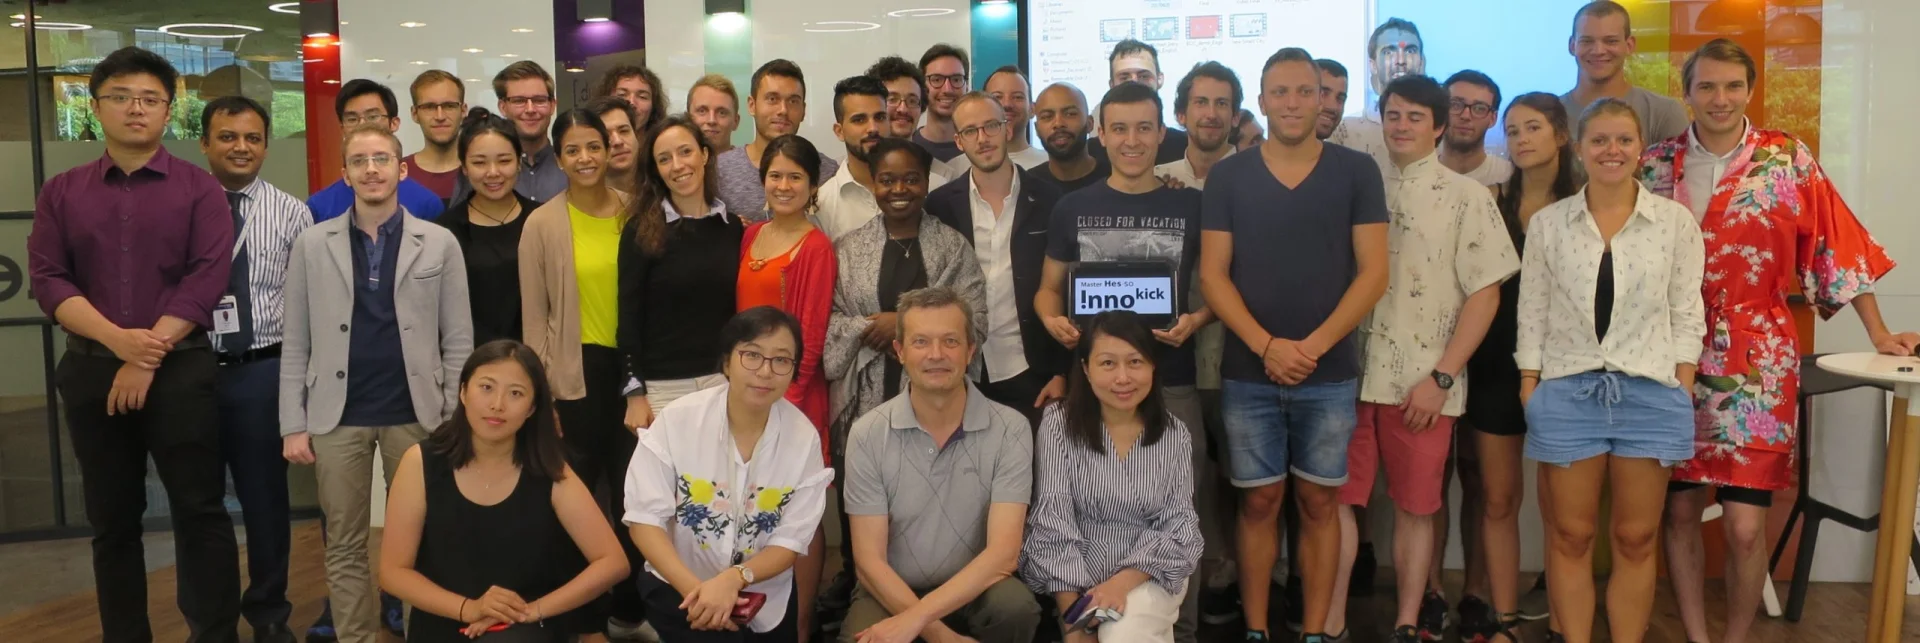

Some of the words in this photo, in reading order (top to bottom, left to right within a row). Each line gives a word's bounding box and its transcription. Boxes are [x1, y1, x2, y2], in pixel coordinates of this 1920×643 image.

[1077, 215, 1112, 228] CLOSED
[1116, 216, 1135, 228] FOR
[1140, 217, 1186, 230] VACATION
